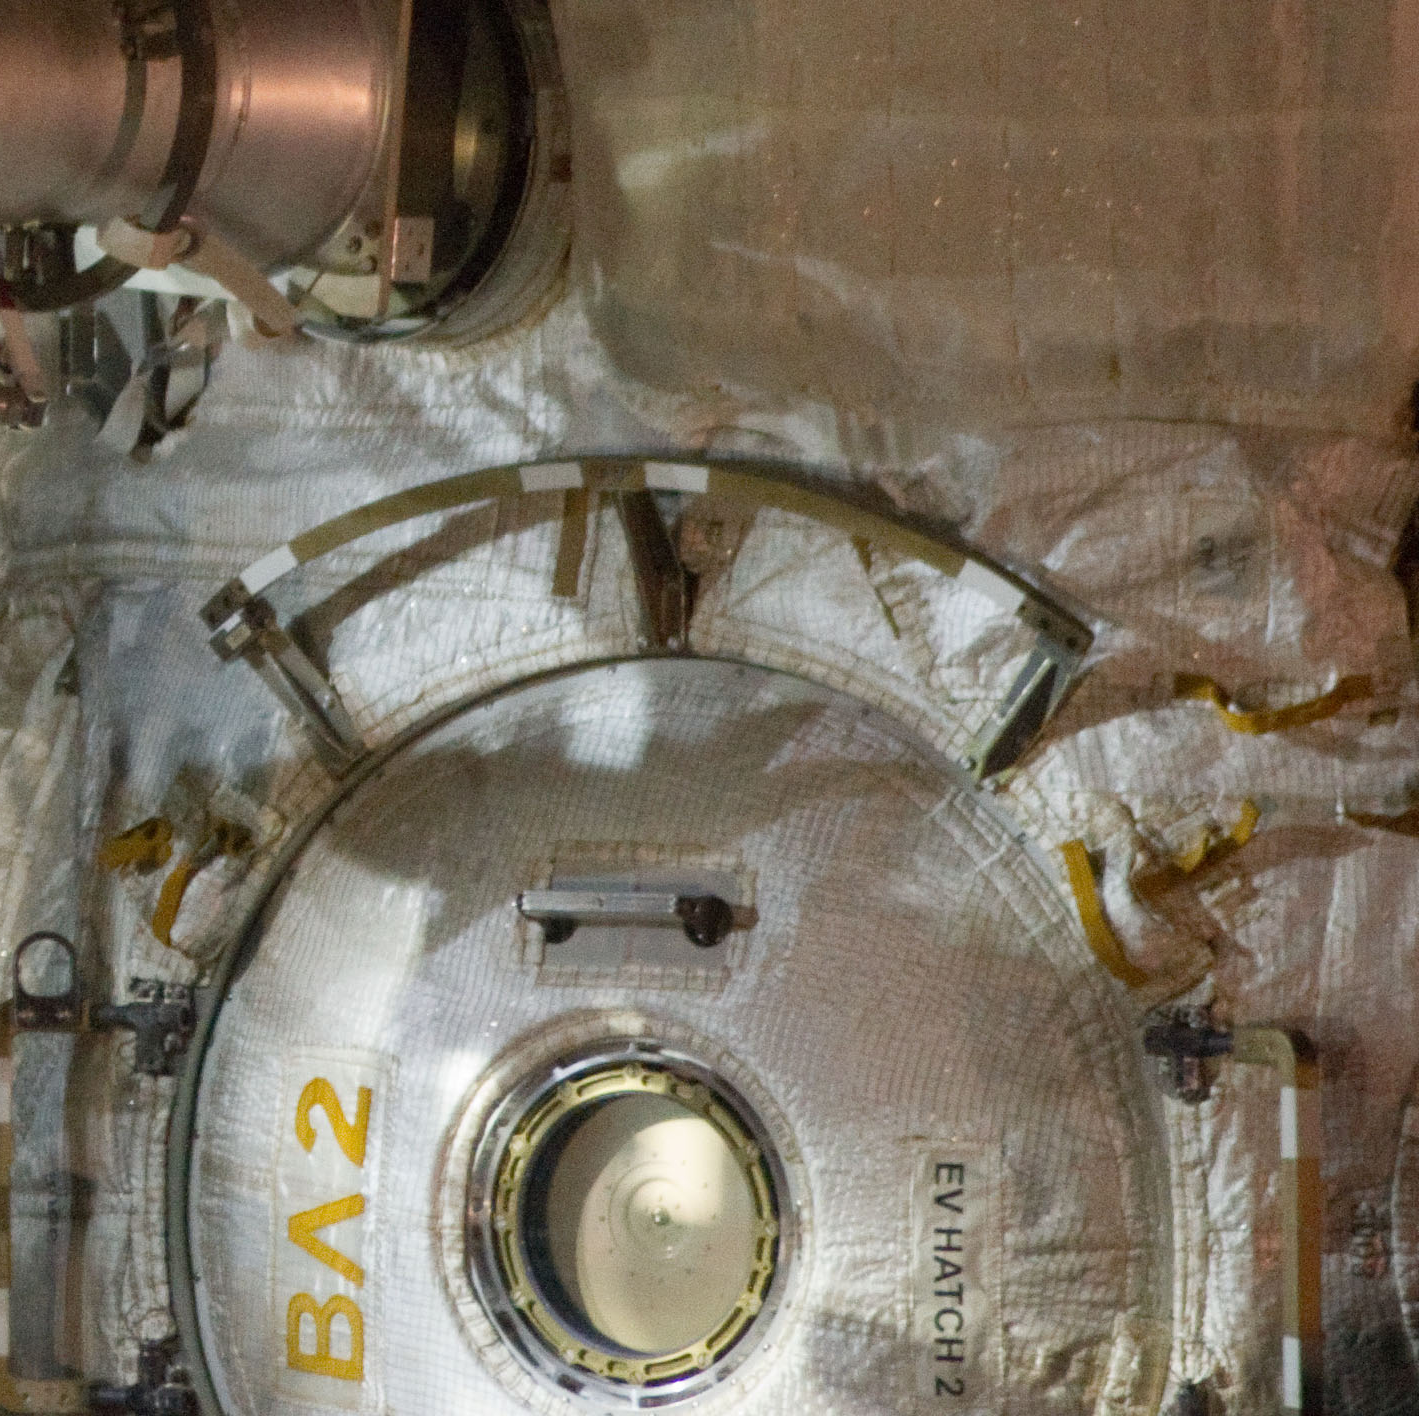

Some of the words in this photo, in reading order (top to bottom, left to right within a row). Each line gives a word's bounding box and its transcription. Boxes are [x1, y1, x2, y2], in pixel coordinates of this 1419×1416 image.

[934, 1163, 965, 1214] EV
[933, 1228, 965, 1362] HATCH
[935, 1375, 966, 1397] 2
